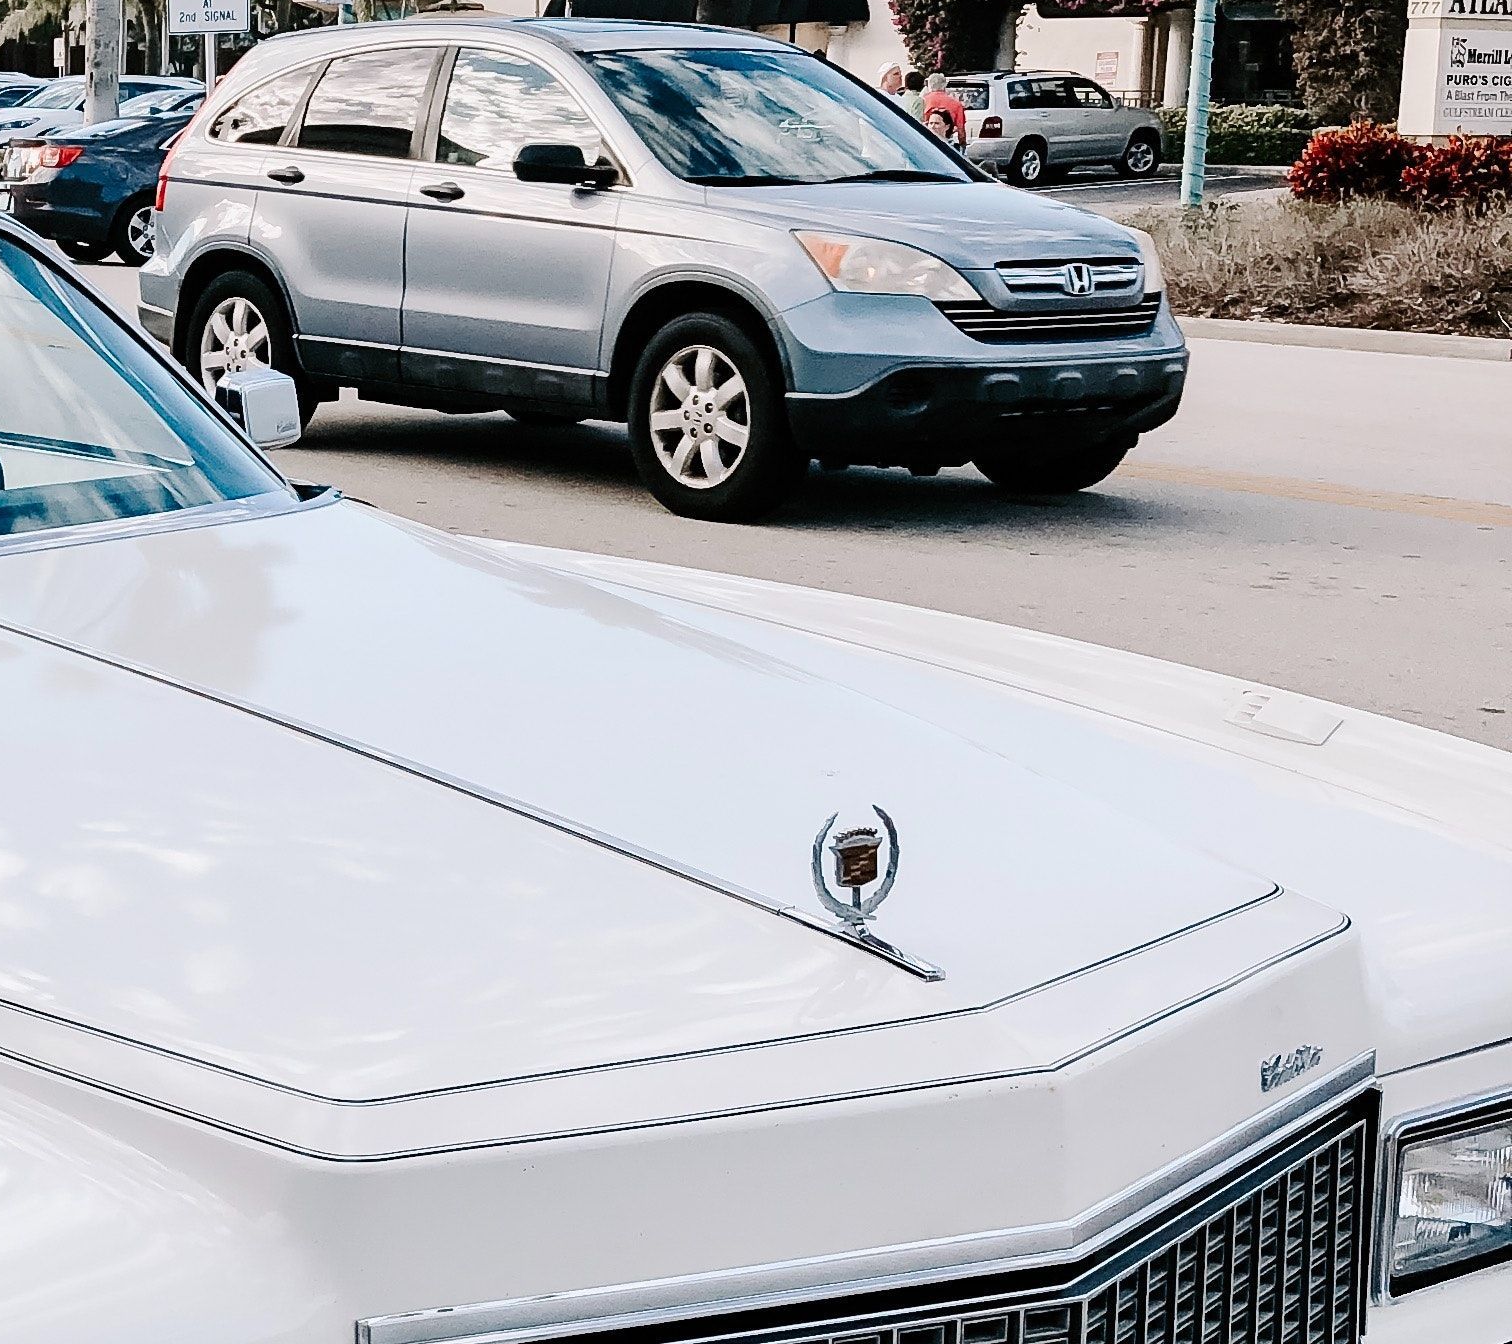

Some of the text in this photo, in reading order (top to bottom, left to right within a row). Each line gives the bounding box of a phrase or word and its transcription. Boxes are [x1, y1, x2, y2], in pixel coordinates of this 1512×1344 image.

[1411, 1, 1440, 14] 777
[179, 10, 236, 22] 2nd SIGNAL
[1467, 49, 1502, 64] Merrill
[1446, 74, 1488, 86] PURO'S
[1446, 89, 1453, 100] A
[1455, 89, 1475, 101] Blast
[1476, 90, 1498, 102] From
